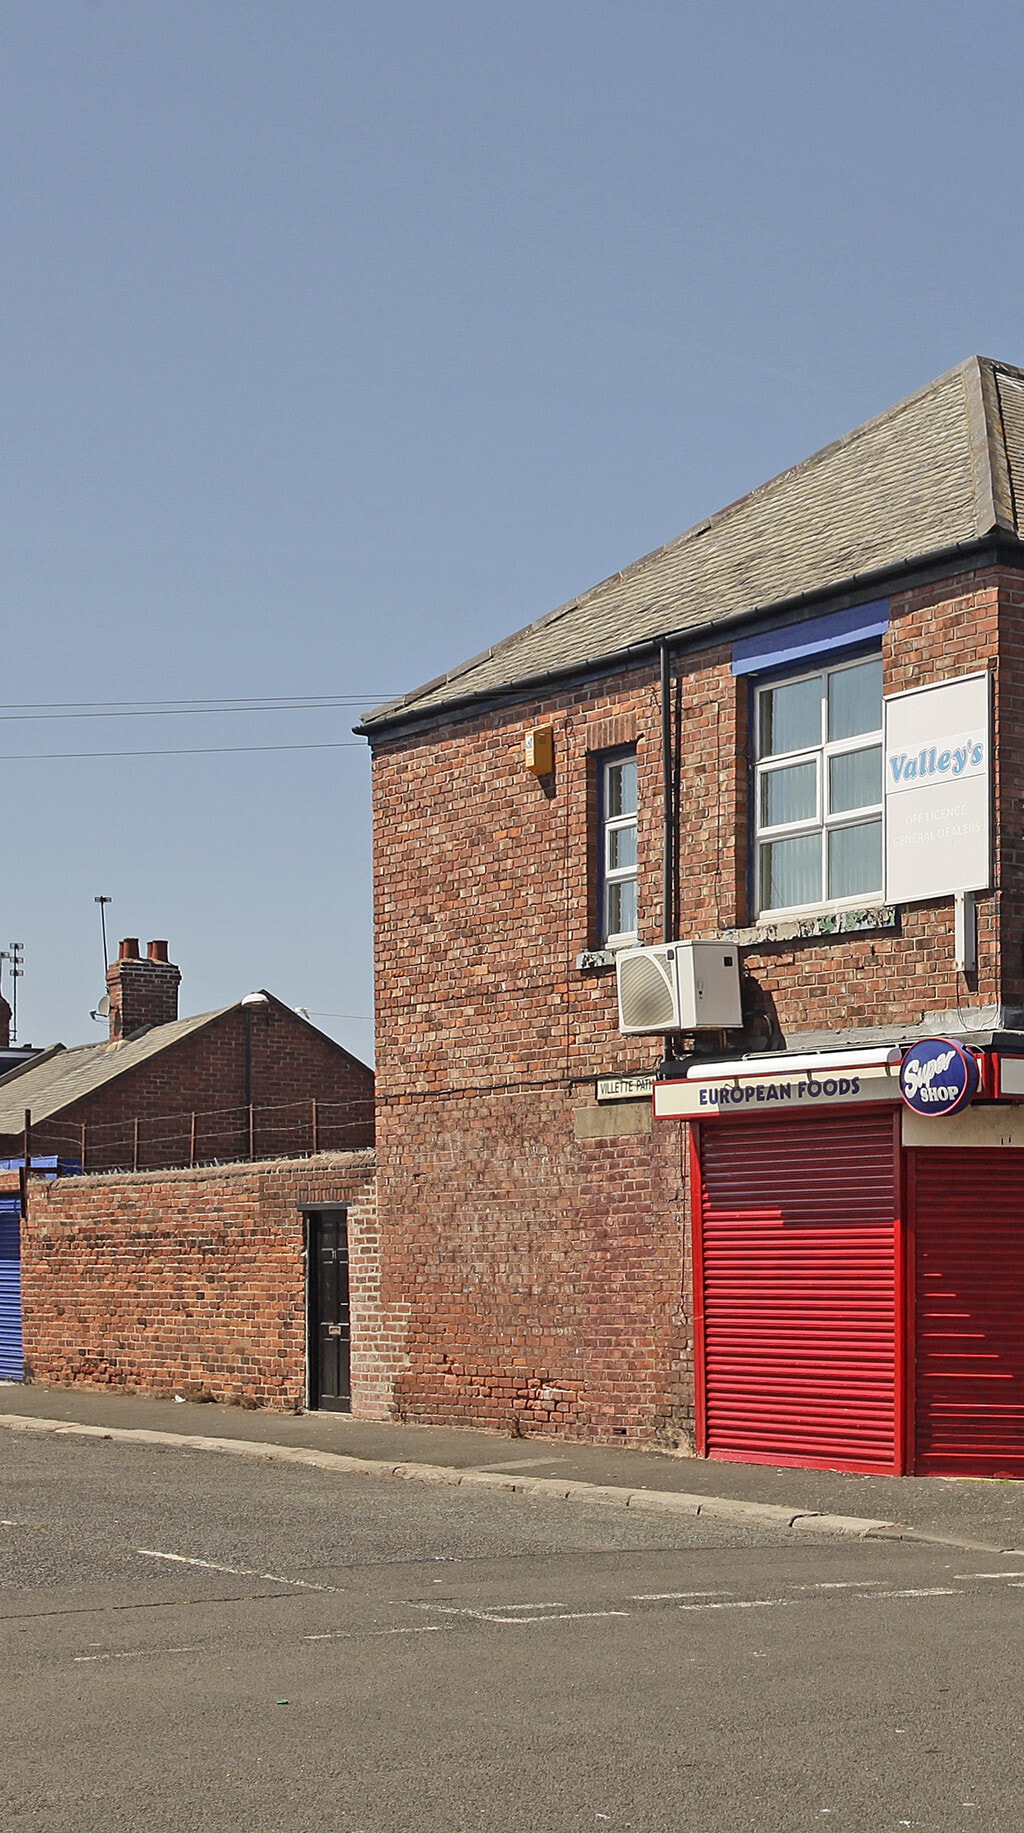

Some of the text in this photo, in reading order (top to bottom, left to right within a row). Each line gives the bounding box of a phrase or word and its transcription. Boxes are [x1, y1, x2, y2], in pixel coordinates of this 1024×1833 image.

[889, 739, 983, 783] Valley's
[905, 805, 967, 826] OFF LICENCE
[893, 822, 982, 848] GENERAL DEALERS
[903, 1050, 956, 1099] Super
[600, 1081, 634, 1095] VILLETTE
[699, 1076, 860, 1106] EUROPEAN FOODS
[920, 1086, 959, 1103] SHOP
